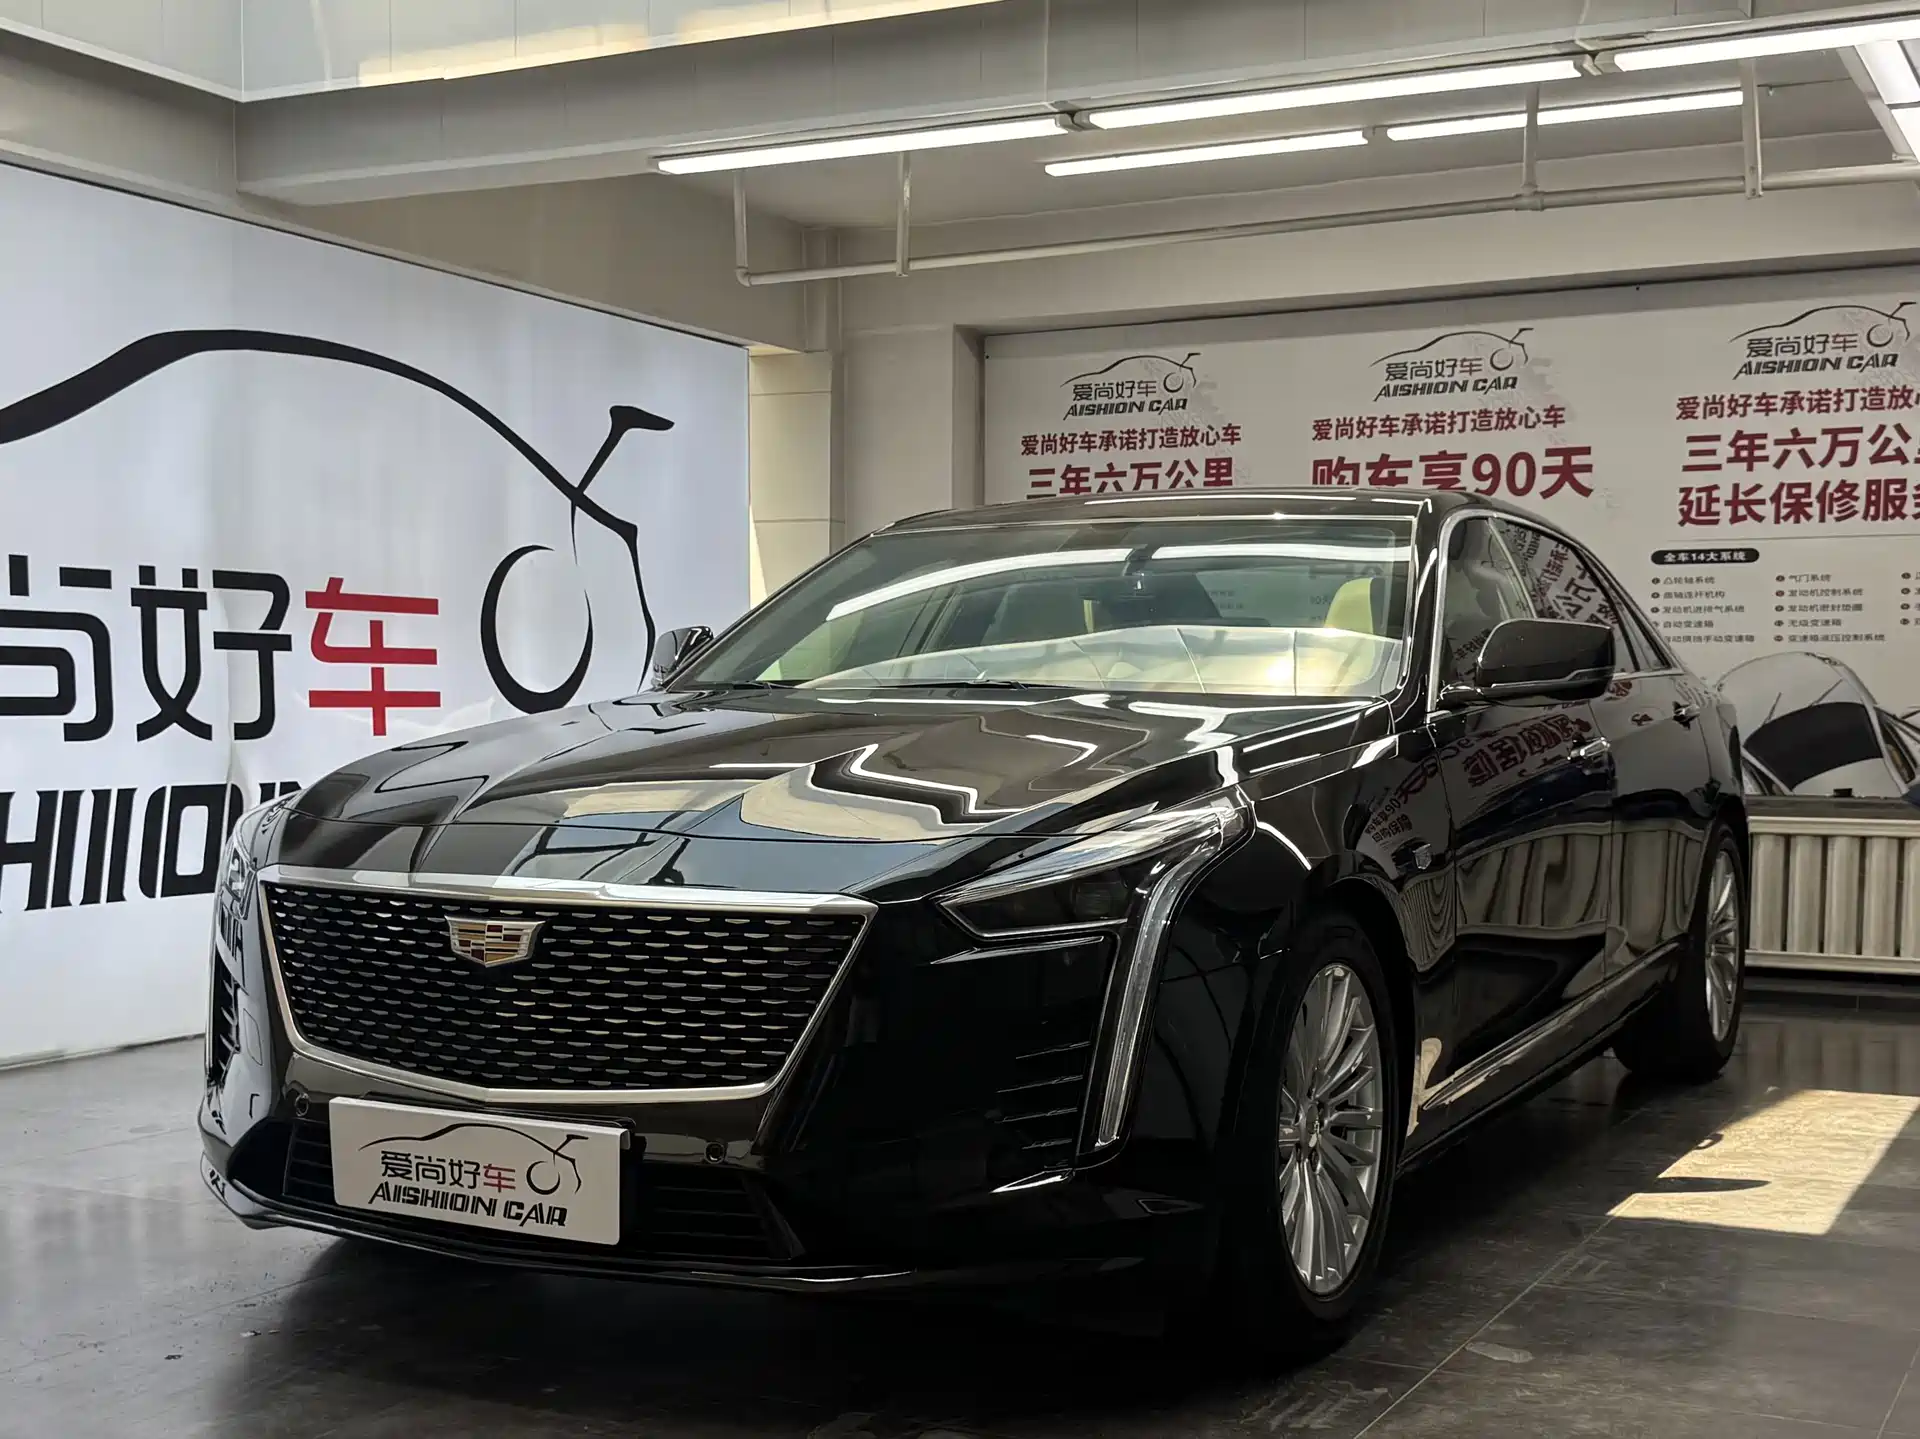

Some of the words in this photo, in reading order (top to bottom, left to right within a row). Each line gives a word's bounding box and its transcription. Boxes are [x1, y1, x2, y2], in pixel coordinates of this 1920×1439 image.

[1746, 333, 1859, 358] 爱尚好车
[1385, 357, 1483, 381] 爱尚好车
[1733, 356, 1842, 380] AISHION
[1846, 353, 1899, 372] CAR
[1072, 379, 1157, 401] 爱尚好车
[1373, 379, 1468, 401] AISHION
[1472, 376, 1518, 394] CAR
[1675, 384, 1920, 421] 爱尚好车承诺打造放
[1063, 400, 1145, 420] AISHION
[1148, 398, 1188, 415] CAR
[1312, 404, 1566, 440] 爱尚好车承诺打造放心车
[1021, 423, 1242, 456] 爱尚好车承诺打造放心车
[1681, 422, 1920, 472] 三年六万公
[1026, 457, 1233, 499] 三年六万公里
[1312, 446, 1593, 499] 购车享90天
[1677, 478, 1920, 527] 延长保修服
[1664, 551, 1747, 563] 全车14大系统
[380, 1150, 517, 1193] 爱尚好车
[368, 1181, 498, 1217] AISHION
[503, 1202, 568, 1227] CAR
